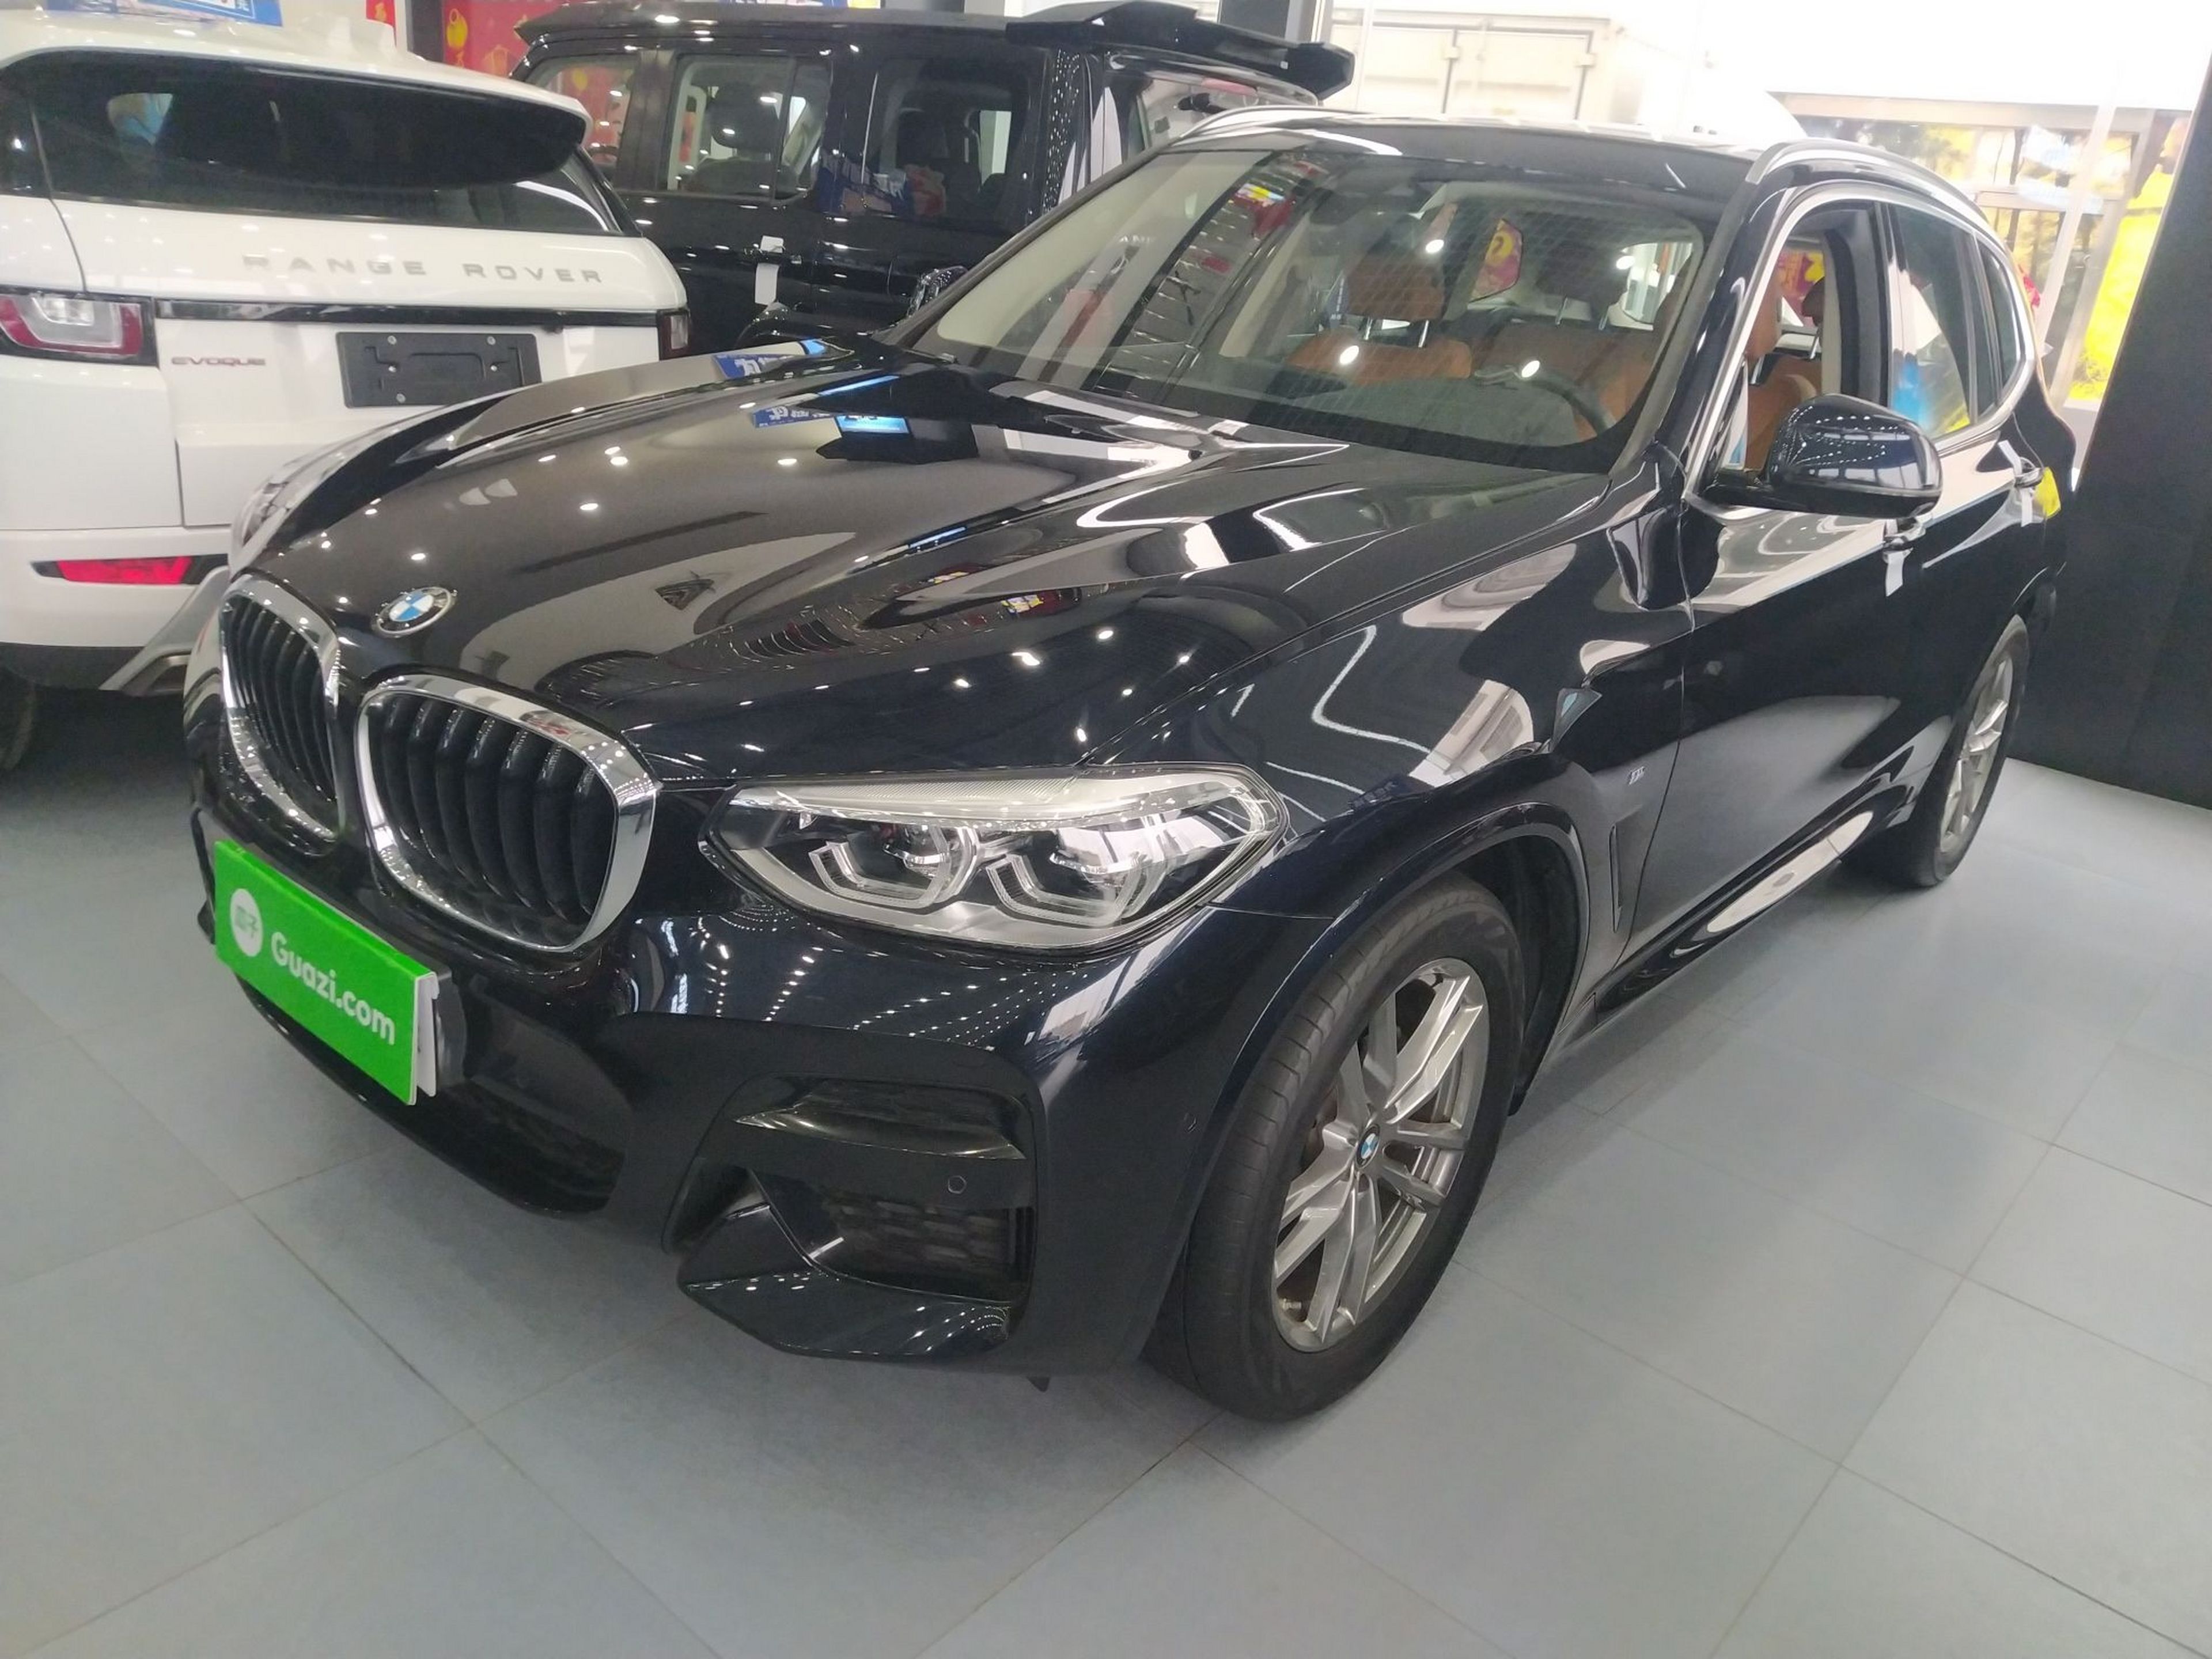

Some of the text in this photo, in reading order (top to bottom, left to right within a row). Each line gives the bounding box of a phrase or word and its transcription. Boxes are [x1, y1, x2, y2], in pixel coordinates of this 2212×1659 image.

[242, 255, 603, 283] RANGE ROVER
[172, 357, 266, 366] EVOQUE
[271, 932, 395, 1046] Guazi.com
